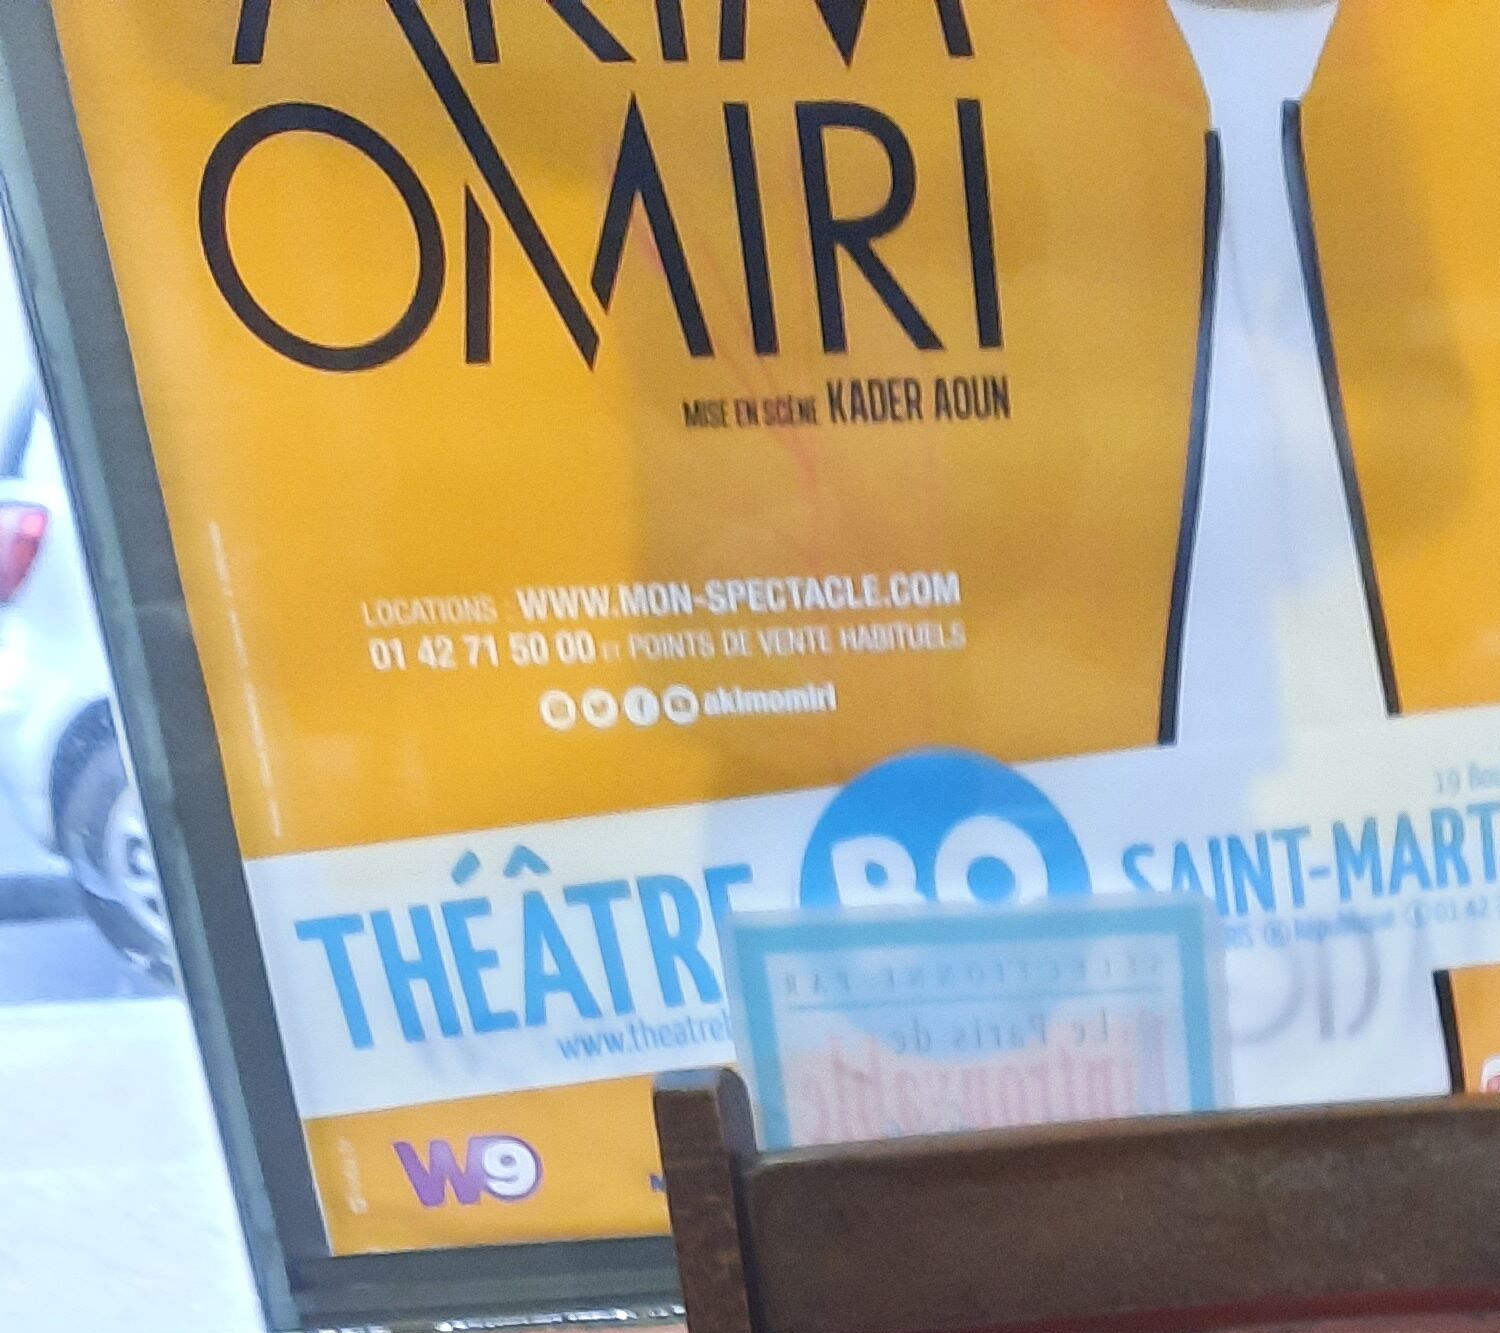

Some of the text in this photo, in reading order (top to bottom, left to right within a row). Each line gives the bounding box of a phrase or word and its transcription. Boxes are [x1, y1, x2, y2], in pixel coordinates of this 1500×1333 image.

[199, 93, 1003, 372] OMIRI
[826, 376, 924, 425] KADER
[934, 373, 1012, 422] AOUN
[362, 571, 961, 628] LOCATIONS WWW.MON-SPECTACLE.COM
[368, 636, 406, 671] 01
[417, 634, 457, 669] 42
[462, 632, 499, 669] 71
[508, 630, 550, 668] 50
[554, 628, 597, 665] 00
[629, 629, 715, 661] POINTS
[757, 623, 832, 658] VENTE
[393, 1134, 543, 1207] W9
